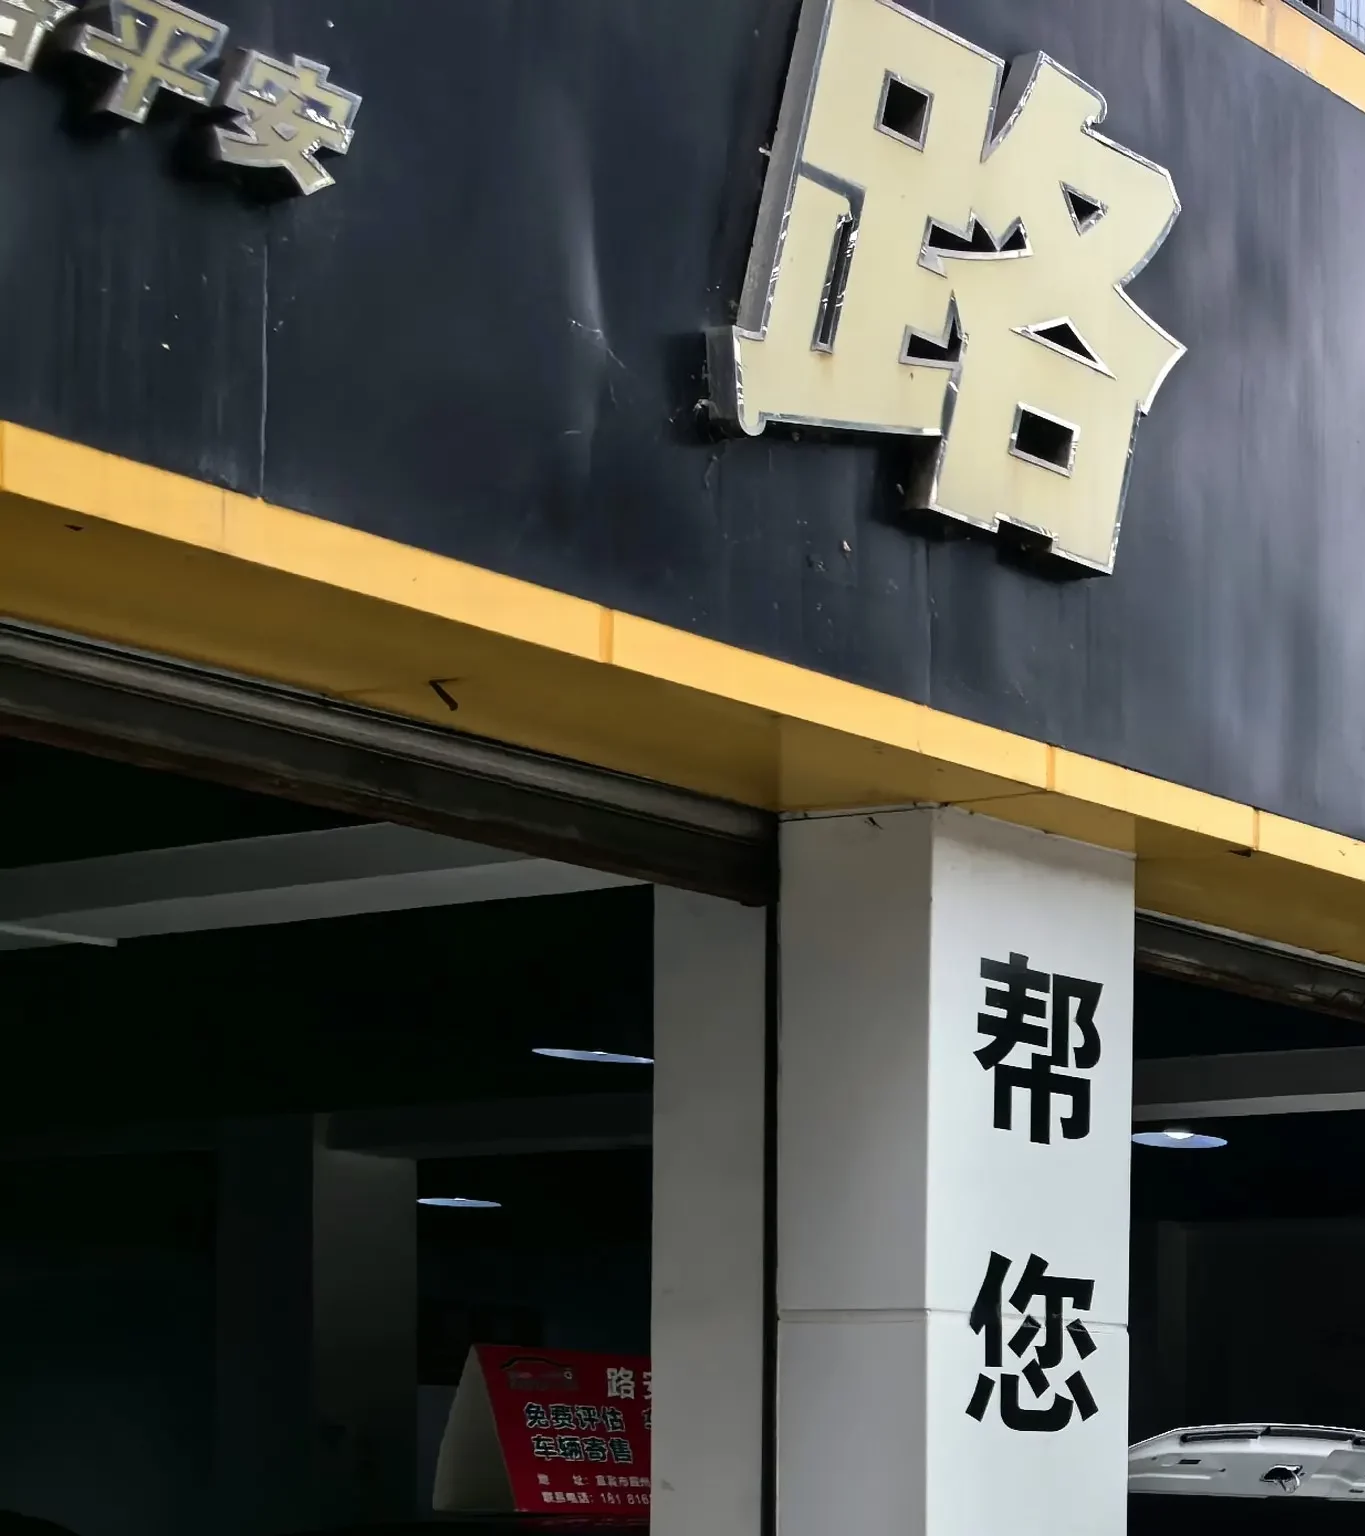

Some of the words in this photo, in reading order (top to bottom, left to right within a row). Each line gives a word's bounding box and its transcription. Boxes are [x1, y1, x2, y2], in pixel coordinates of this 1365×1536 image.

[523, 1402, 626, 1432] 免费评估
[531, 1434, 634, 1464] 车辆寄售
